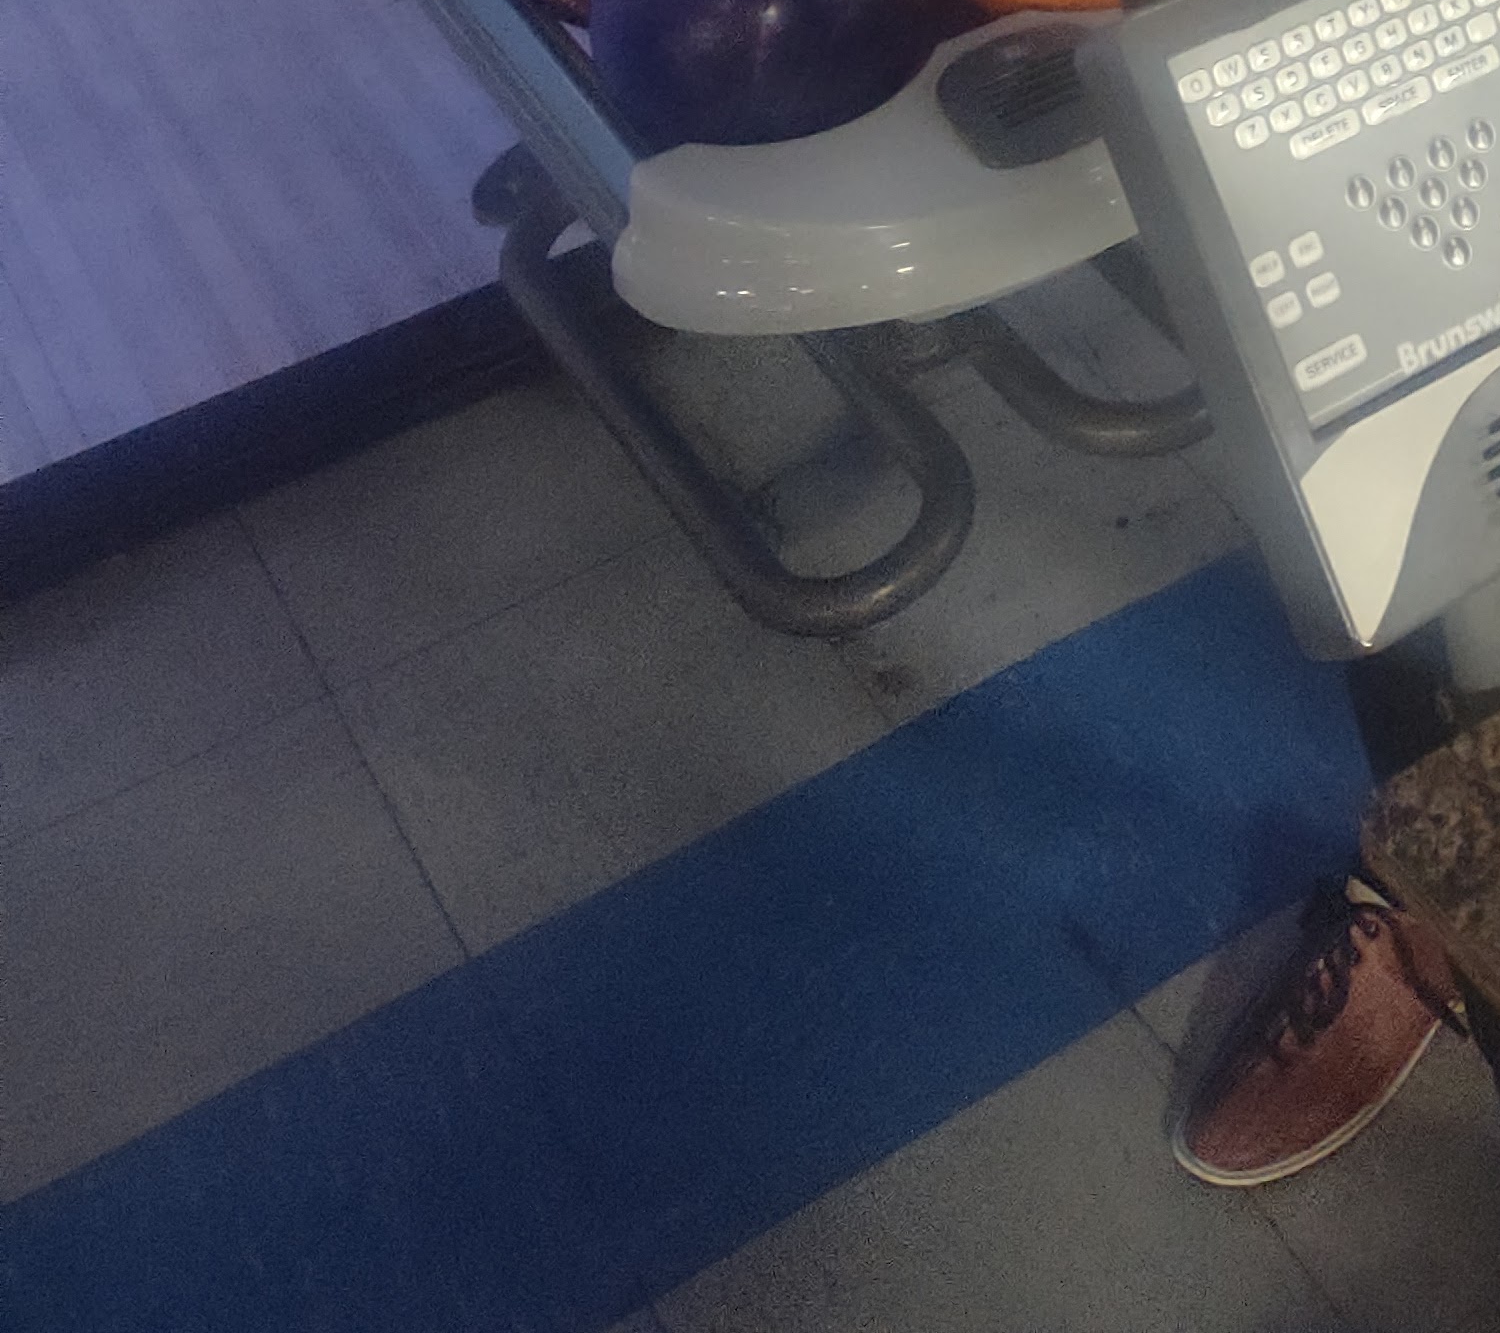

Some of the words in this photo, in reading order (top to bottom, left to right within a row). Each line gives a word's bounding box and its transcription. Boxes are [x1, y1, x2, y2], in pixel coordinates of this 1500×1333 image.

[1325, 17, 1336, 33] T
[1253, 85, 1266, 102] S
[1315, 92, 1328, 108] C
[1303, 343, 1361, 382] SERVICE
